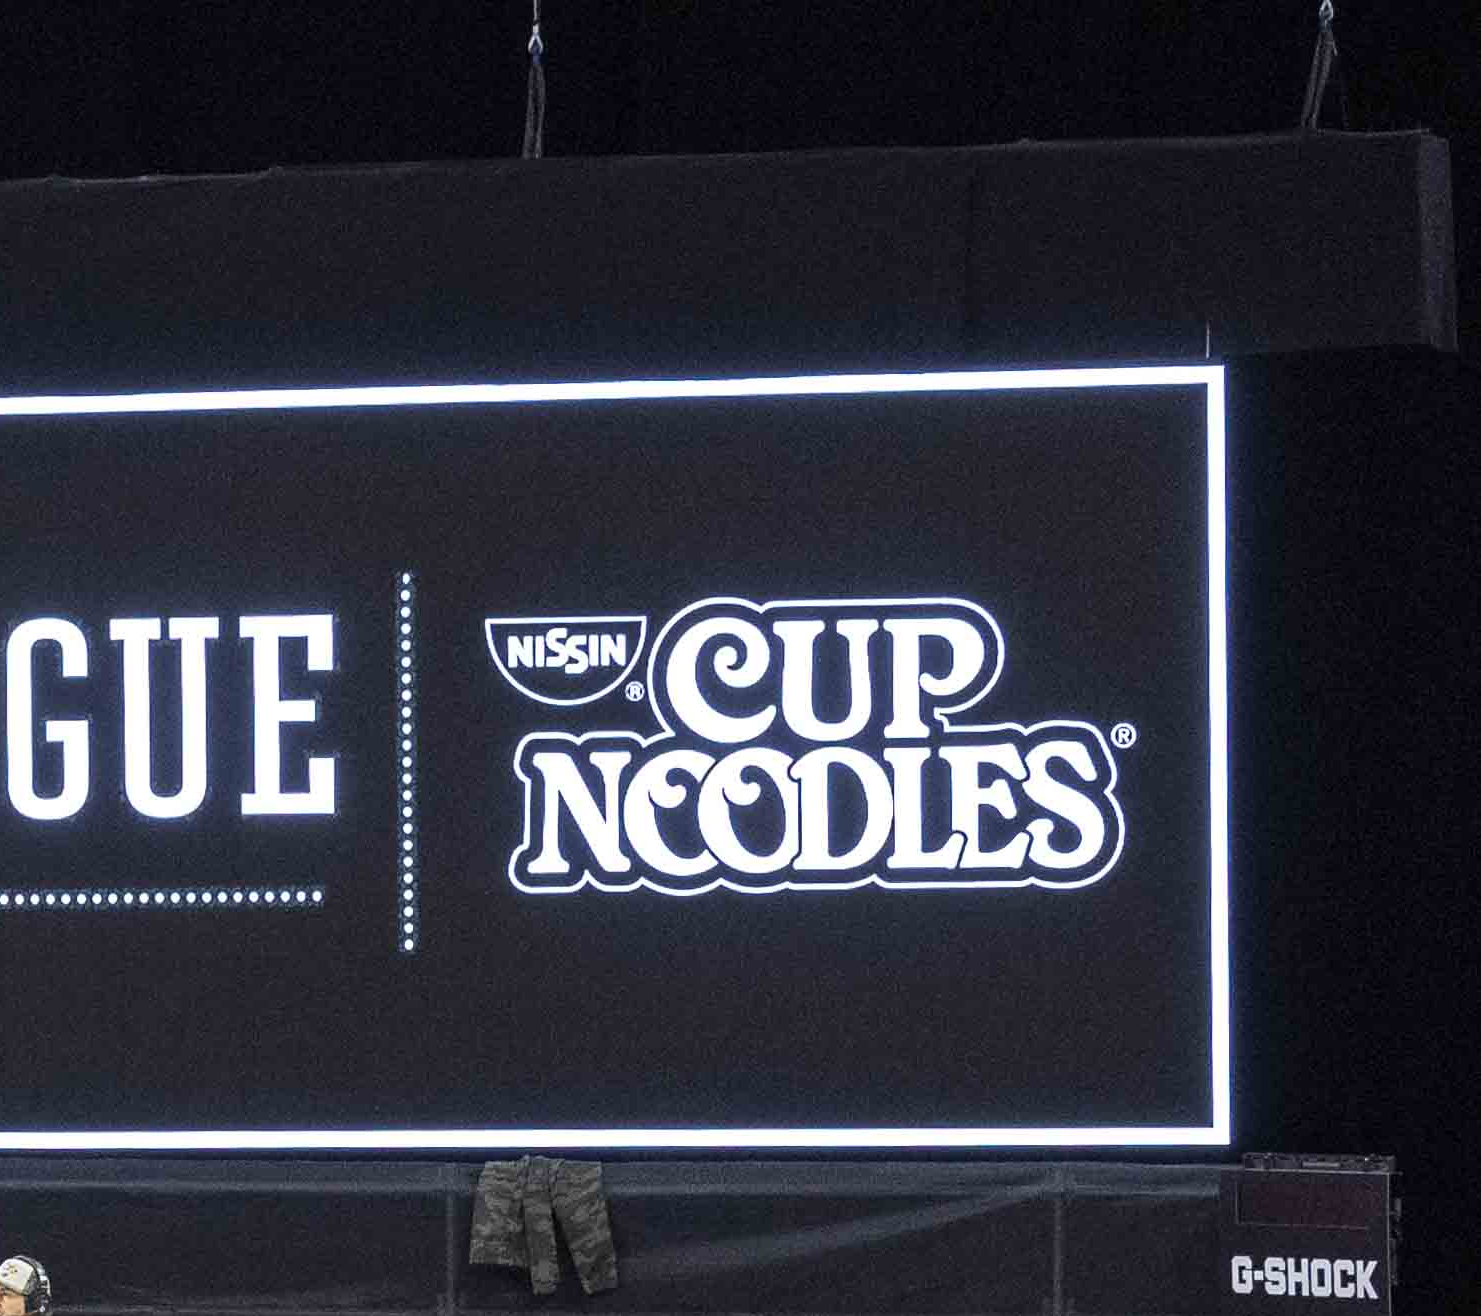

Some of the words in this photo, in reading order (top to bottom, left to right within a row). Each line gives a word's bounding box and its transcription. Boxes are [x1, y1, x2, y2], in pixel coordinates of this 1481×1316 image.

[507, 628, 627, 675] NISSIN
[665, 616, 985, 743] CUP
[527, 741, 1106, 877] NOODLES
[1231, 1255, 1379, 1299] G-SHOCK
